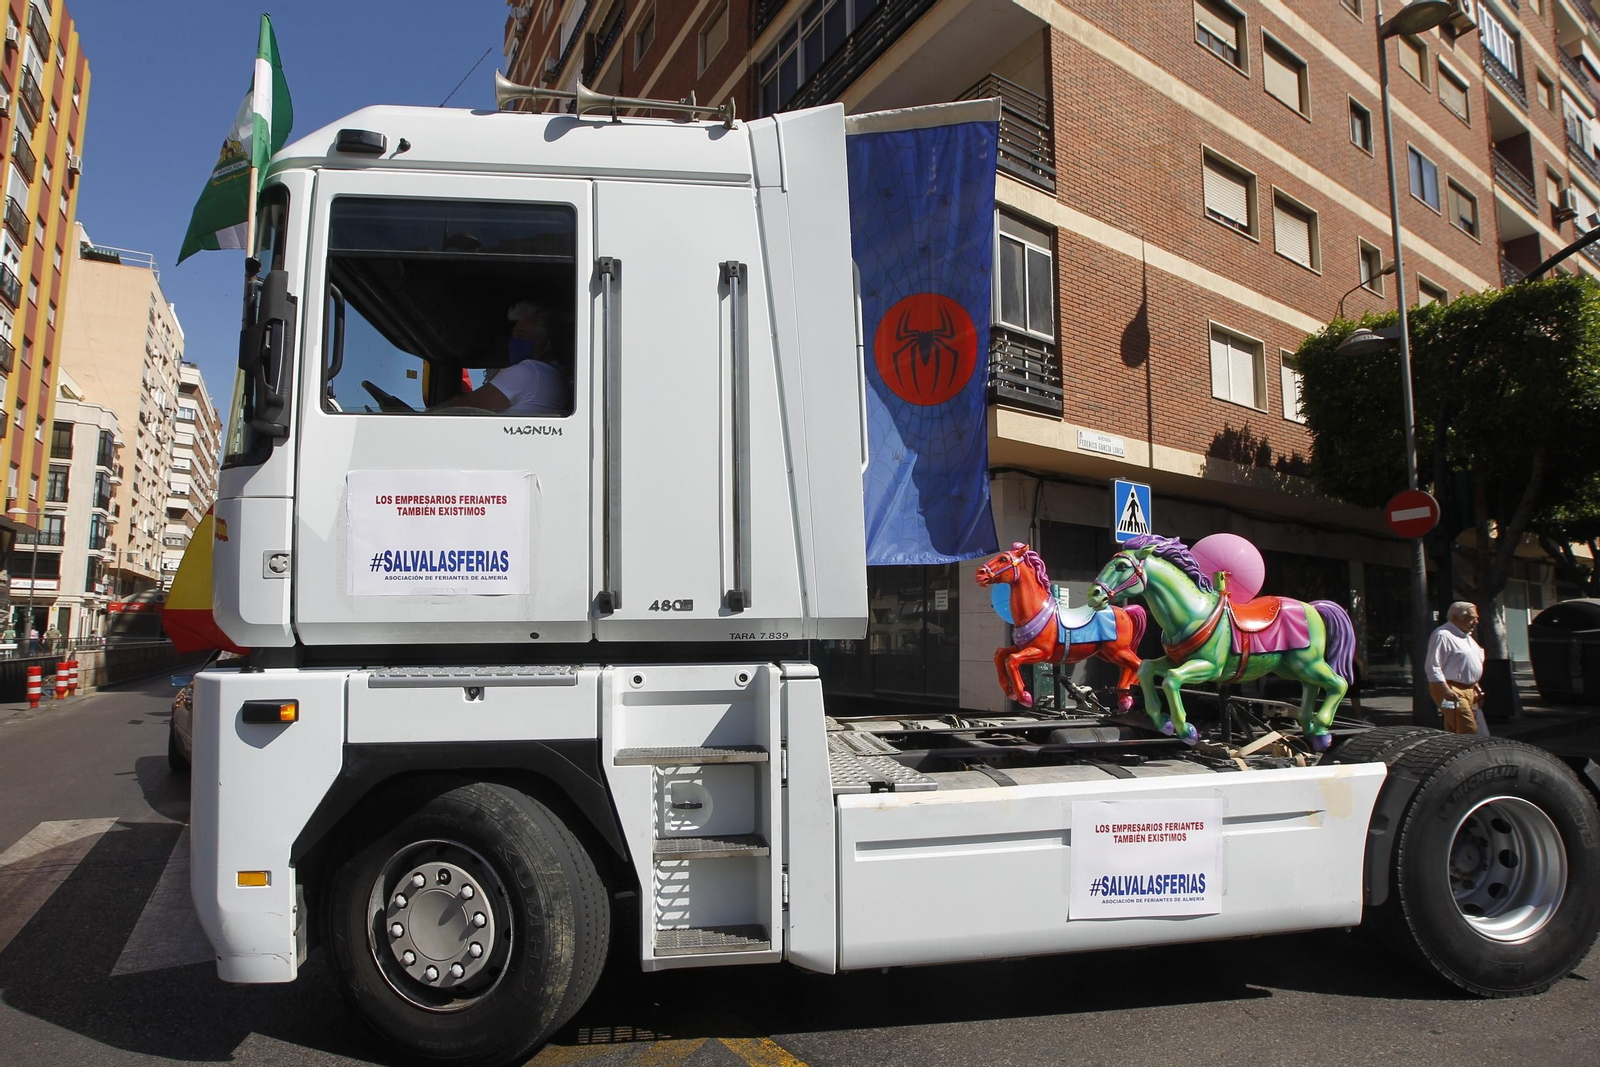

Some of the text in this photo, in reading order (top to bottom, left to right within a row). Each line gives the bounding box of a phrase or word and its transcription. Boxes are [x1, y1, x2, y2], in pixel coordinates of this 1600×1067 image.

[503, 425, 563, 436] MAGNUM
[1079, 439, 1097, 449] FEDERICO
[1112, 446, 1124, 455] LORCA
[375, 495, 508, 505] LOS EMPRESARIOS FERIANTES
[397, 505, 486, 516] TAMBIÉN EXISTIMOS
[370, 550, 509, 573] #SALVALASFERIAS
[729, 632, 789, 640] TARA 7.839
[1452, 765, 1518, 798] MICHELIN
[1095, 821, 1204, 833] LOS EMPRESARIOS FERIANTES
[1114, 833, 1187, 844] TAMBIÉN EXISTIMOS
[1089, 873, 1206, 897] #SALVALASFERIAS
